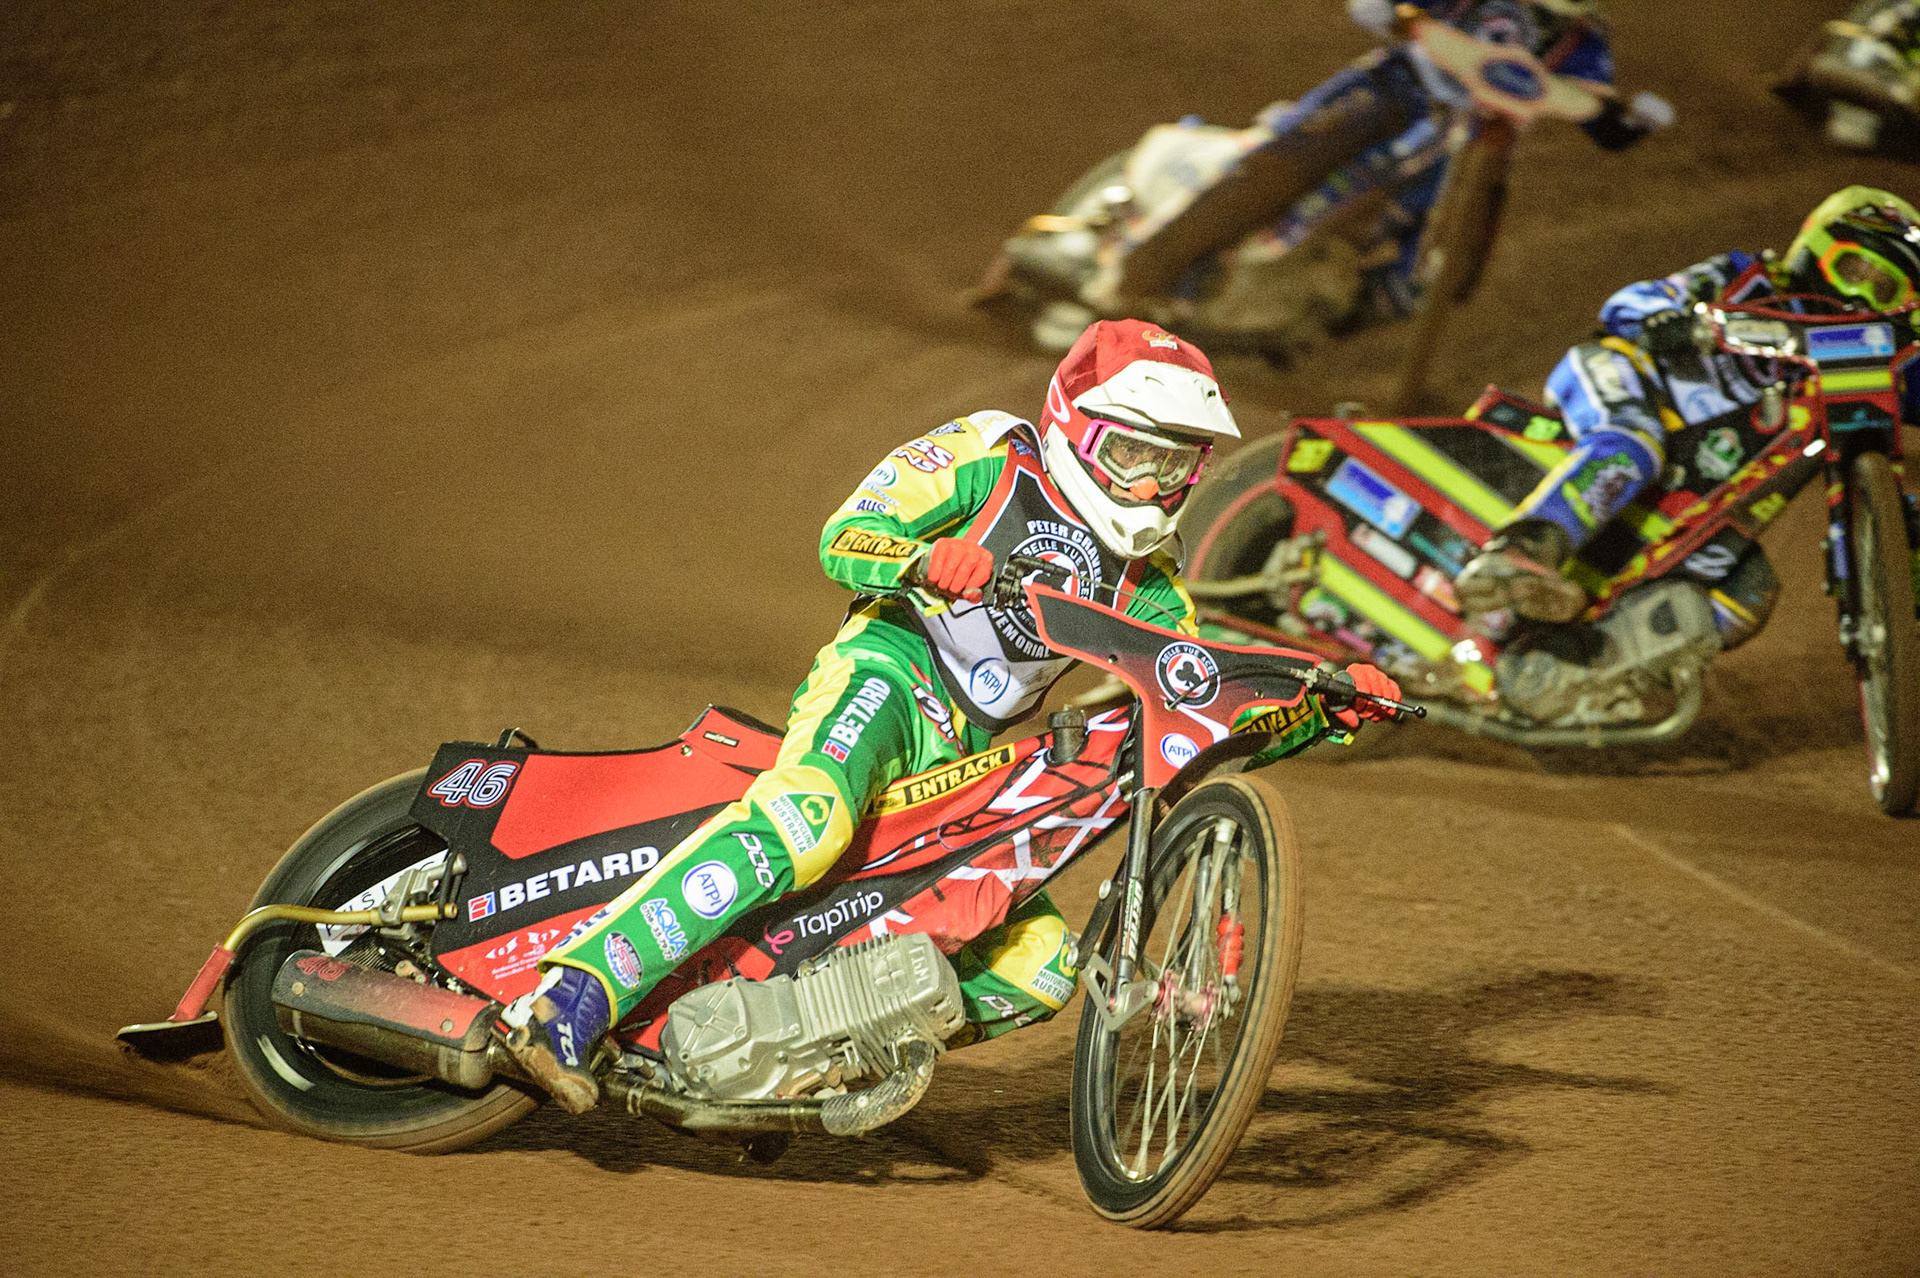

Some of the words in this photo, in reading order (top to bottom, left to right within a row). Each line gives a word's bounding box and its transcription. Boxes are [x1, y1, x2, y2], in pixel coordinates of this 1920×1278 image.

[856, 499, 886, 513] AUS
[1027, 520, 1069, 538] PETER
[1022, 540, 1058, 556] BELLE
[1063, 544, 1084, 567] VUE
[987, 605, 1050, 658] MEMORIAL
[1161, 646, 1181, 664] BELLE
[1183, 646, 1200, 656] VUE
[978, 668, 1003, 695] ATPI
[836, 677, 891, 749] BETARD
[910, 749, 1004, 802] ENTRACK
[1168, 745, 1193, 759] ATPI
[428, 759, 519, 807] 46
[770, 800, 806, 854] AUSTRALIA
[780, 796, 814, 849] MOTORCYCLING
[500, 846, 660, 911] BETARD
[697, 873, 722, 907] ATPI
[649, 900, 686, 956] AQUA
[794, 891, 883, 938] TapTrip
[1039, 970, 1074, 994] MOTORCYC
